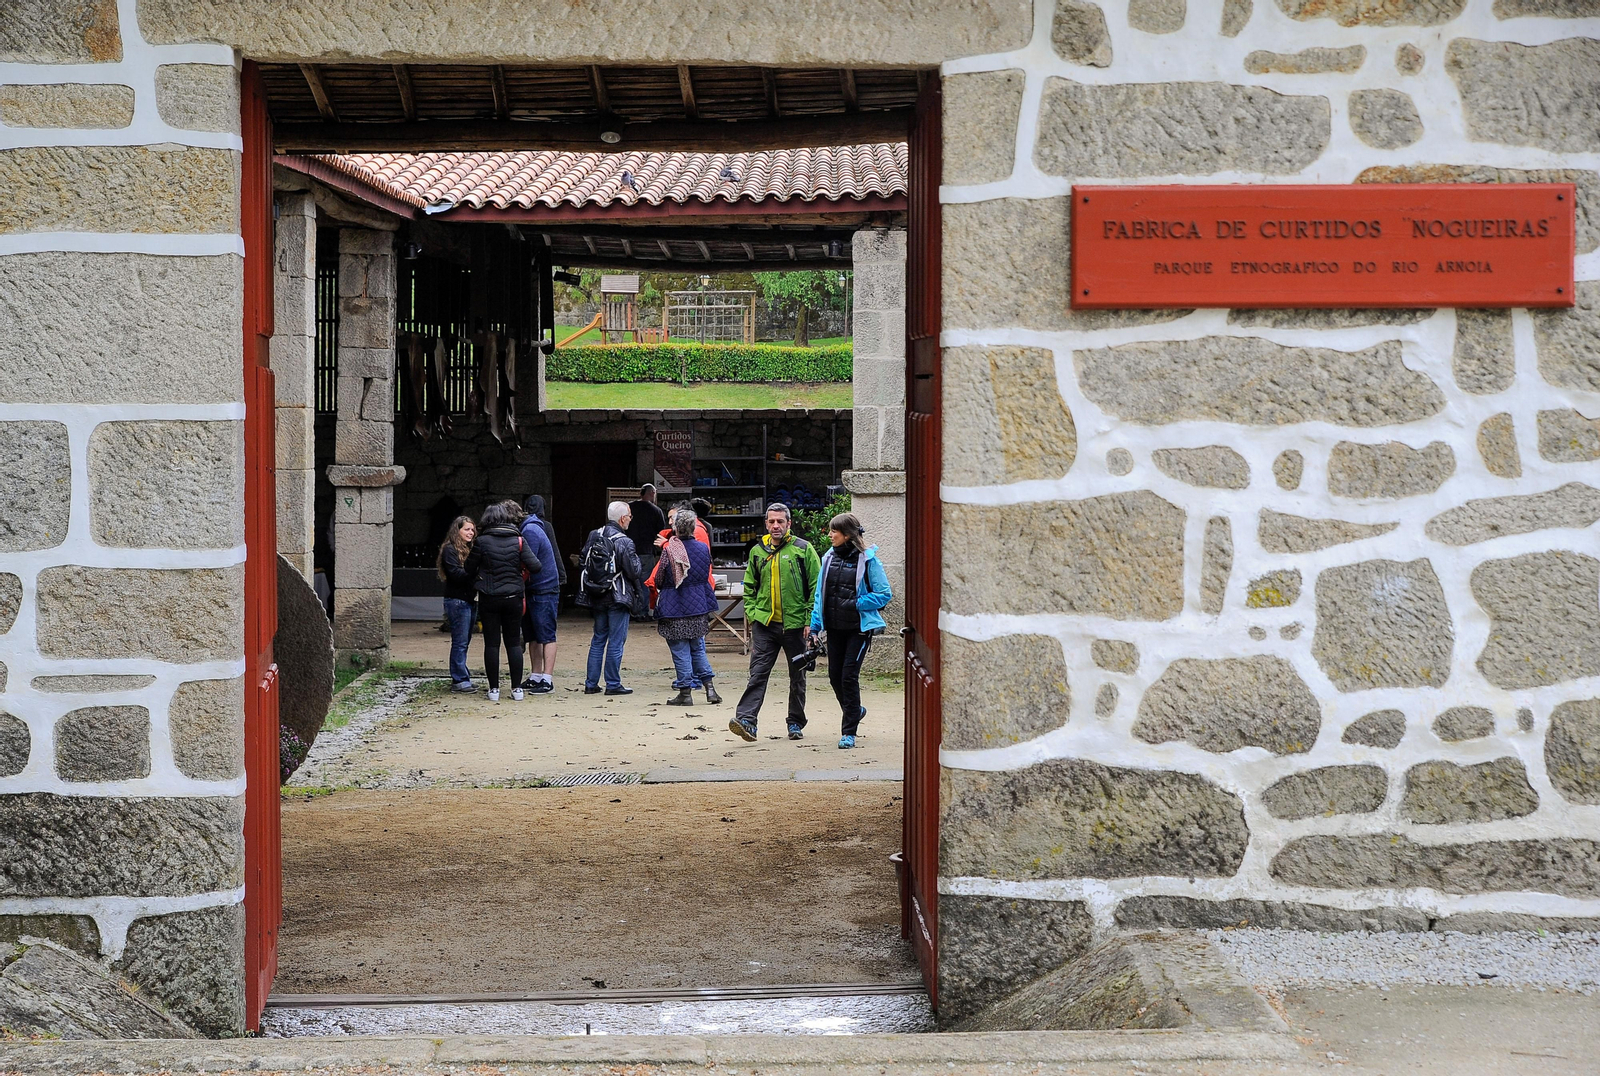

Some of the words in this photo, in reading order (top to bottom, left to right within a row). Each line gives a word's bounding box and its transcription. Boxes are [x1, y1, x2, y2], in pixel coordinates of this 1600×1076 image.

[1103, 220, 1202, 239] FABRICA
[1216, 220, 1247, 239] DE
[1259, 220, 1382, 239] CURTIDOS
[1153, 262, 1213, 275] PARQUE
[1230, 261, 1339, 274] ETNOGRAFICO
[1353, 261, 1377, 273] DO
[1392, 261, 1419, 274] RIO
[1435, 260, 1493, 274] ARNOIA
[656, 431, 691, 441] Curtidos
[662, 441, 691, 451] Queiro
